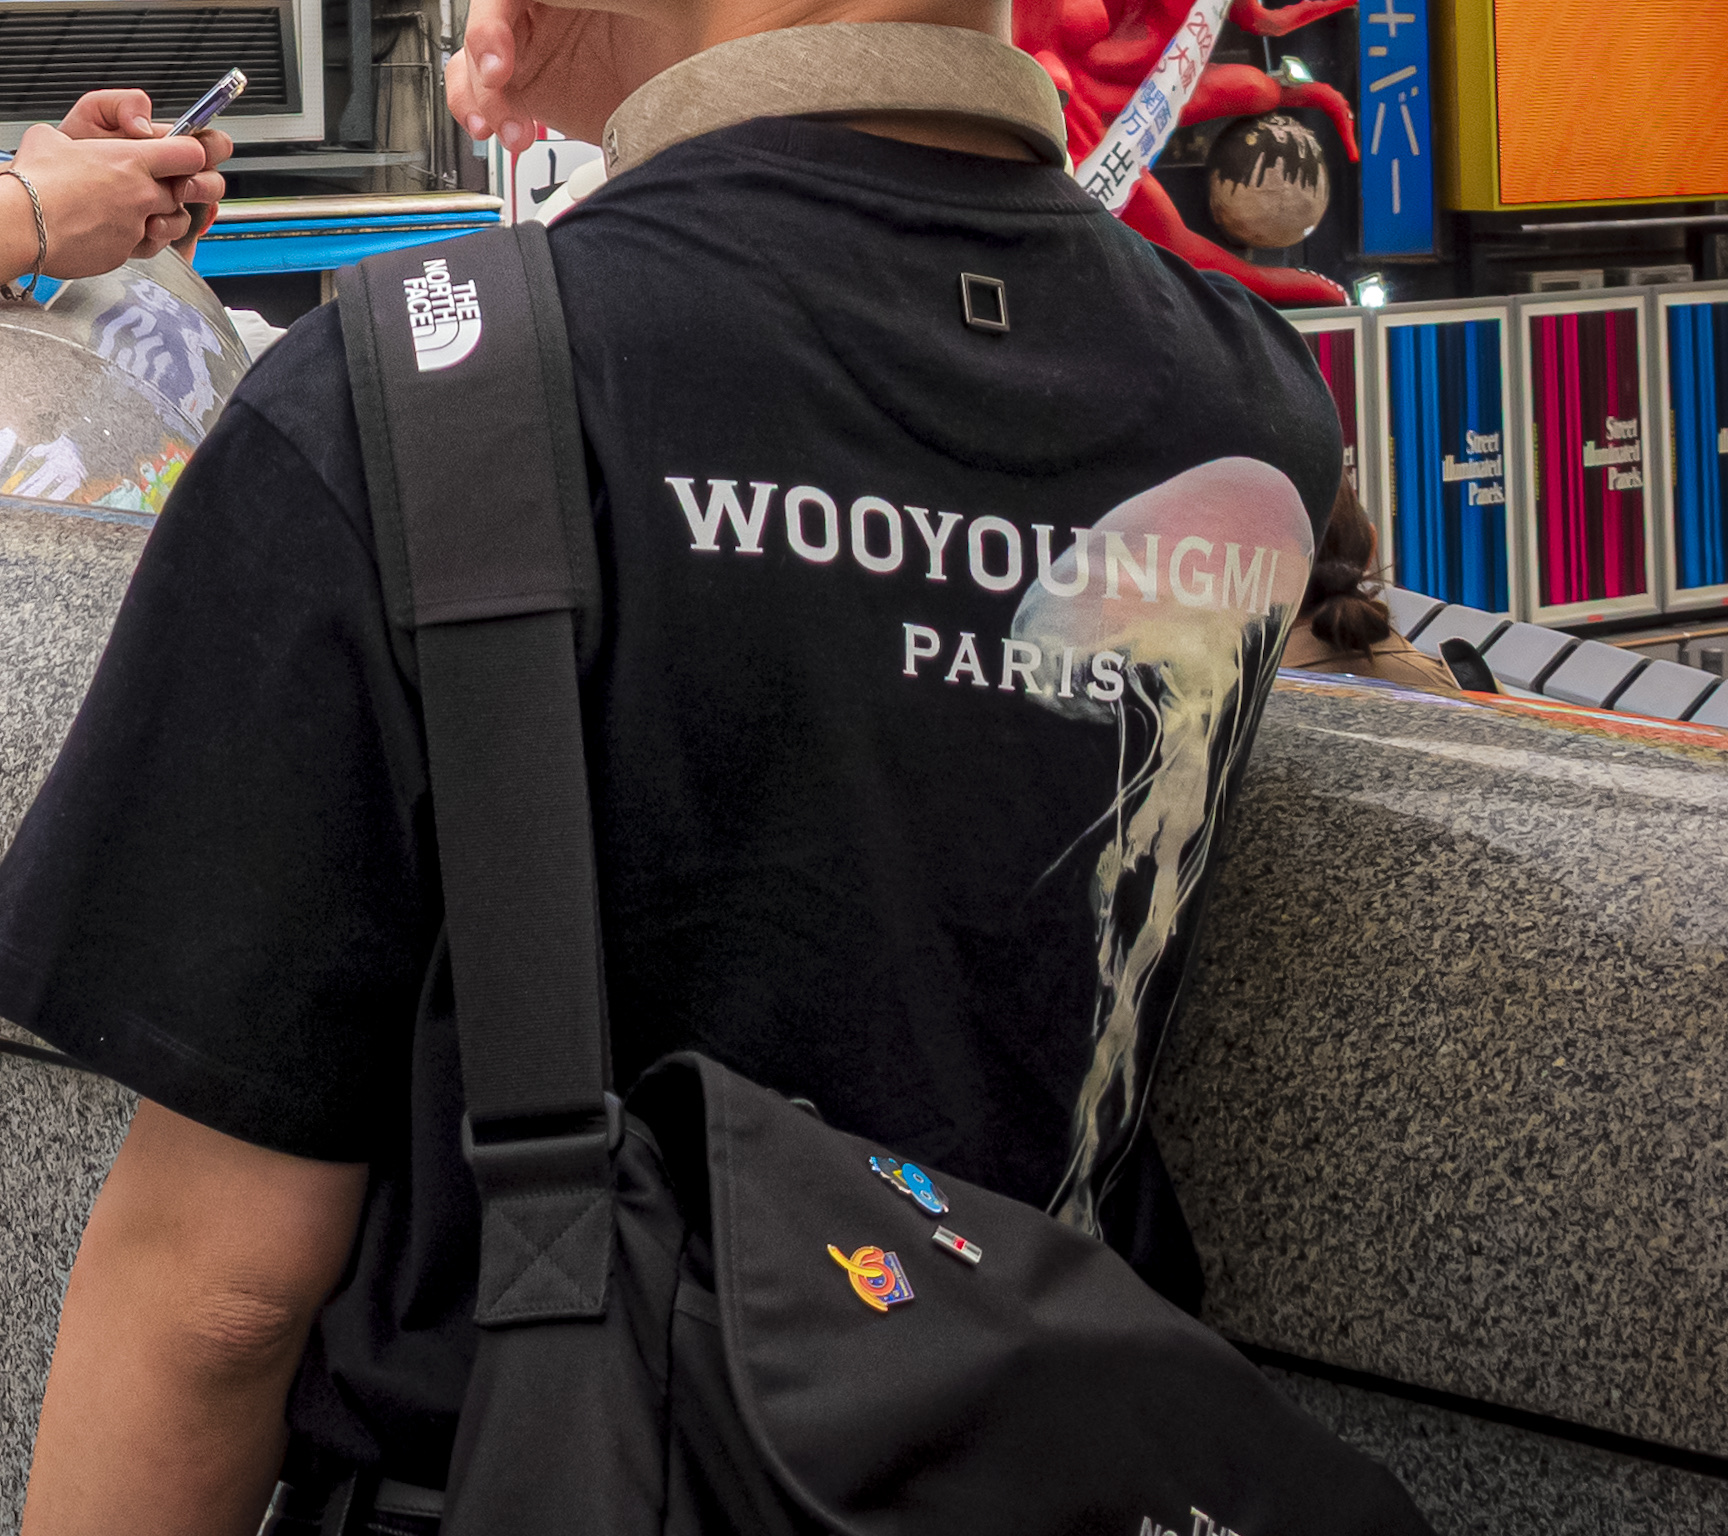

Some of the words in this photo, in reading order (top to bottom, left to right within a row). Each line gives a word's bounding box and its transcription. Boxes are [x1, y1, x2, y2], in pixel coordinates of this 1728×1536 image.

[402, 277, 433, 328] FACE
[422, 258, 458, 323] NORTH
[452, 279, 481, 321] THE
[664, 476, 1280, 617] WOOYOUNGMI
[902, 622, 1126, 704] PARIS
